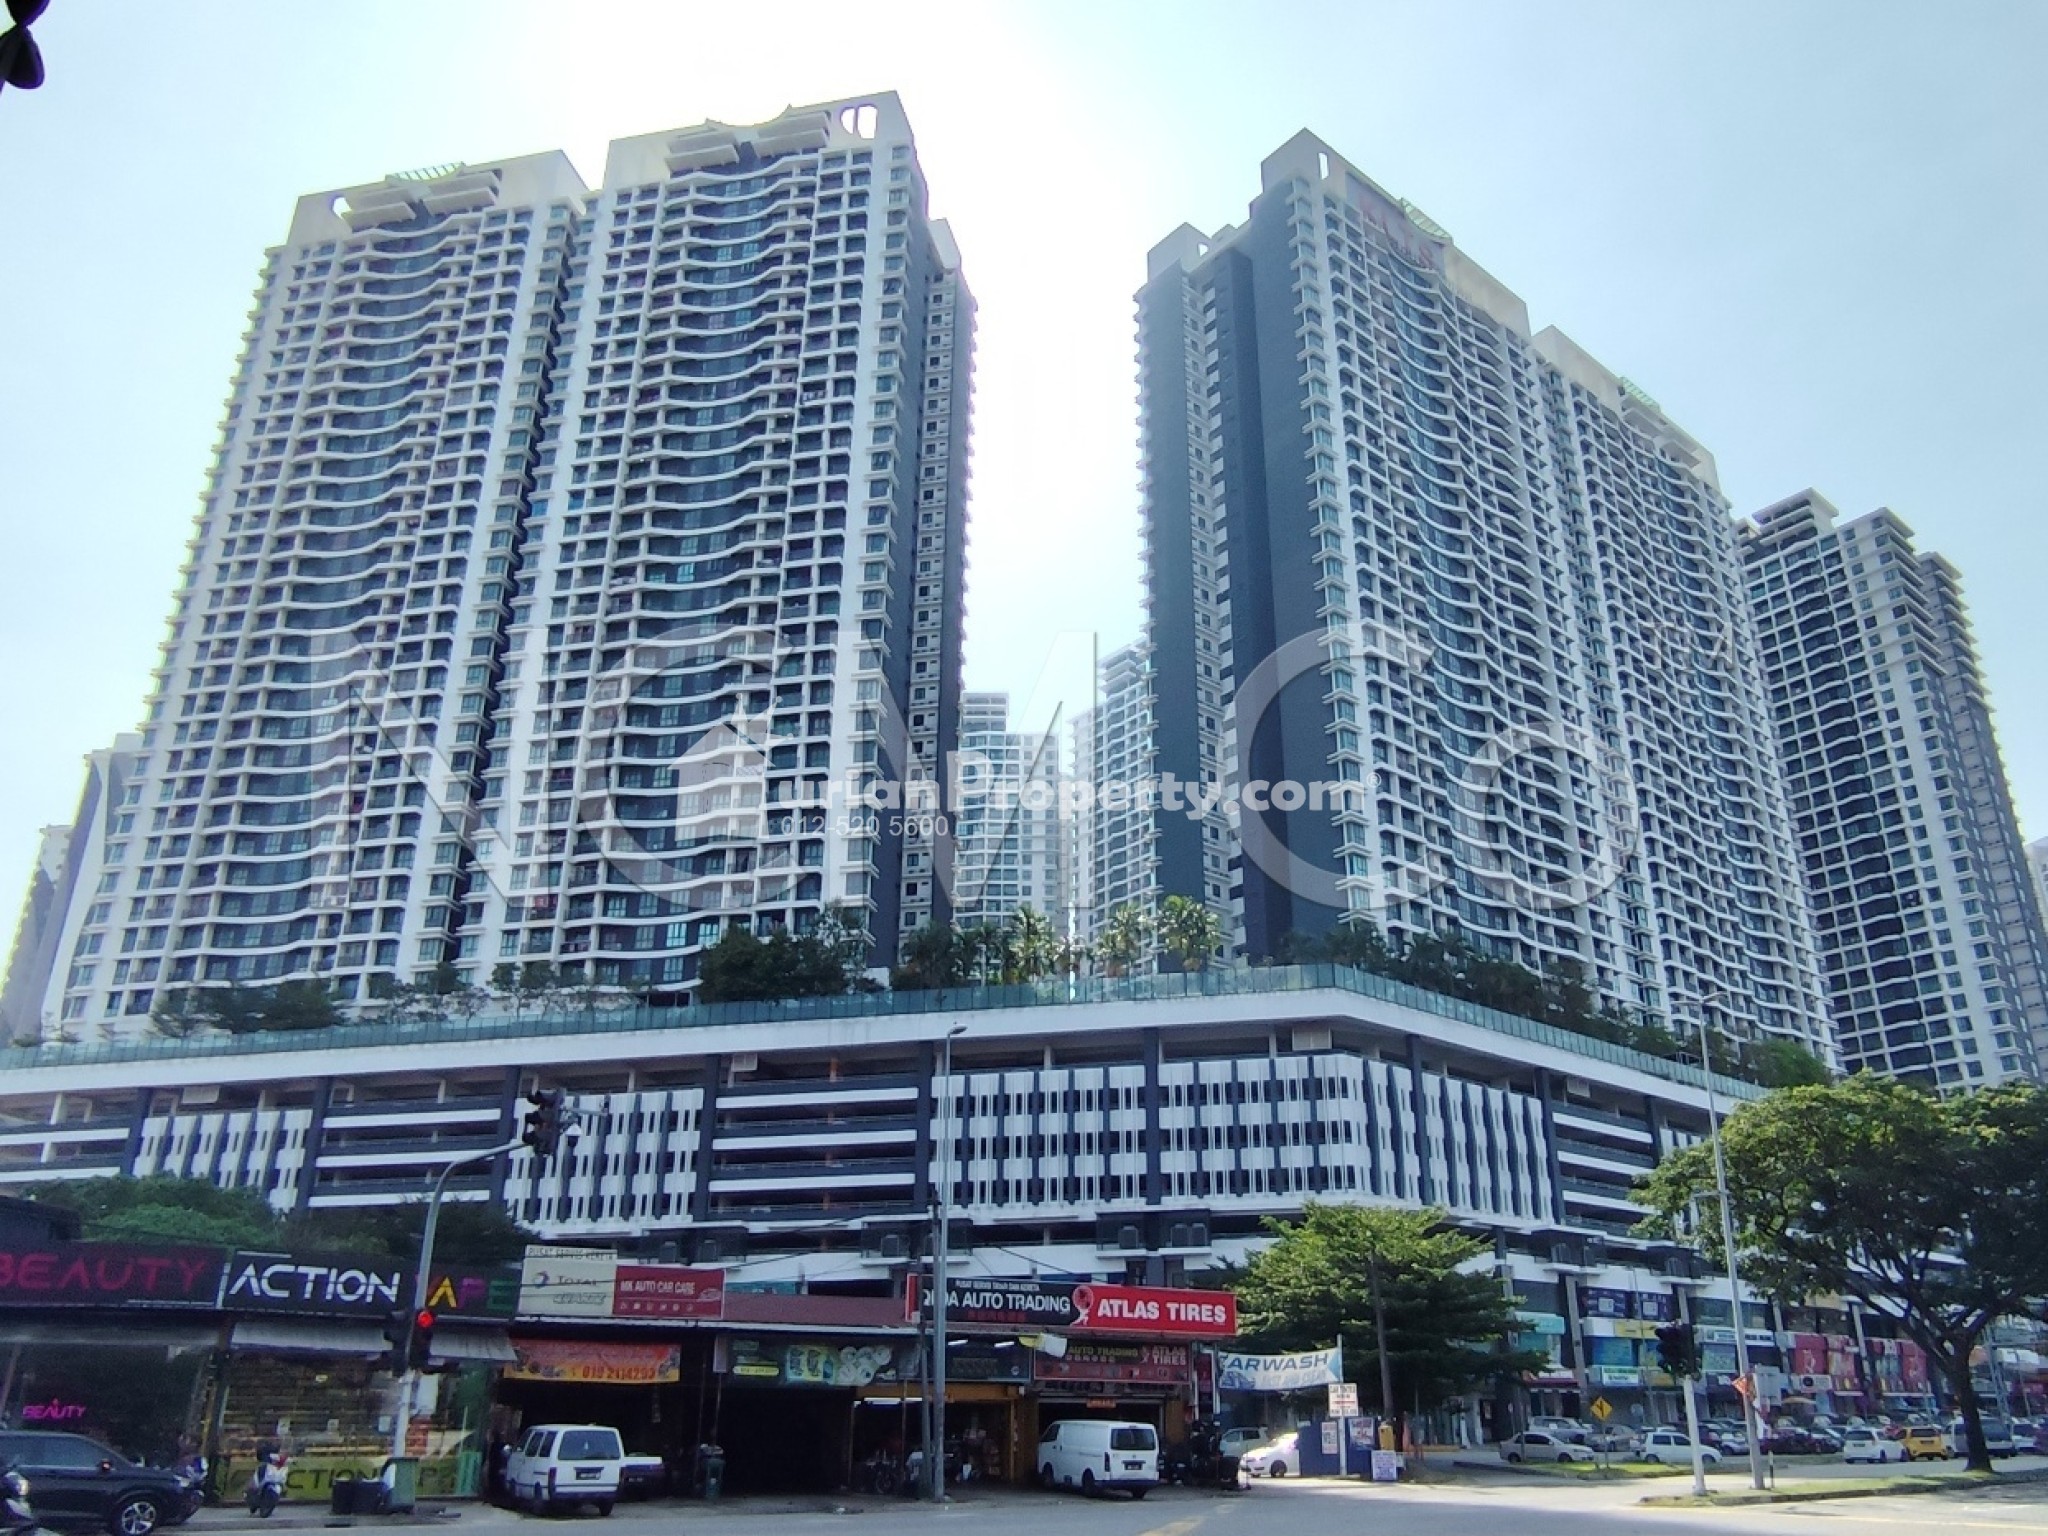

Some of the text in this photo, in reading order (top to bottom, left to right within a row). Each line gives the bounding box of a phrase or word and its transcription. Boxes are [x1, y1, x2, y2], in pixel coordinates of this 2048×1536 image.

[229, 1263, 400, 1303] ACTION
[635, 1281, 656, 1293] AUTO
[658, 1281, 673, 1293] CAR
[962, 1291, 1003, 1309] AUTO
[1006, 1294, 1070, 1312] TRADING
[1097, 1298, 1226, 1323] ATLAS TIRES
